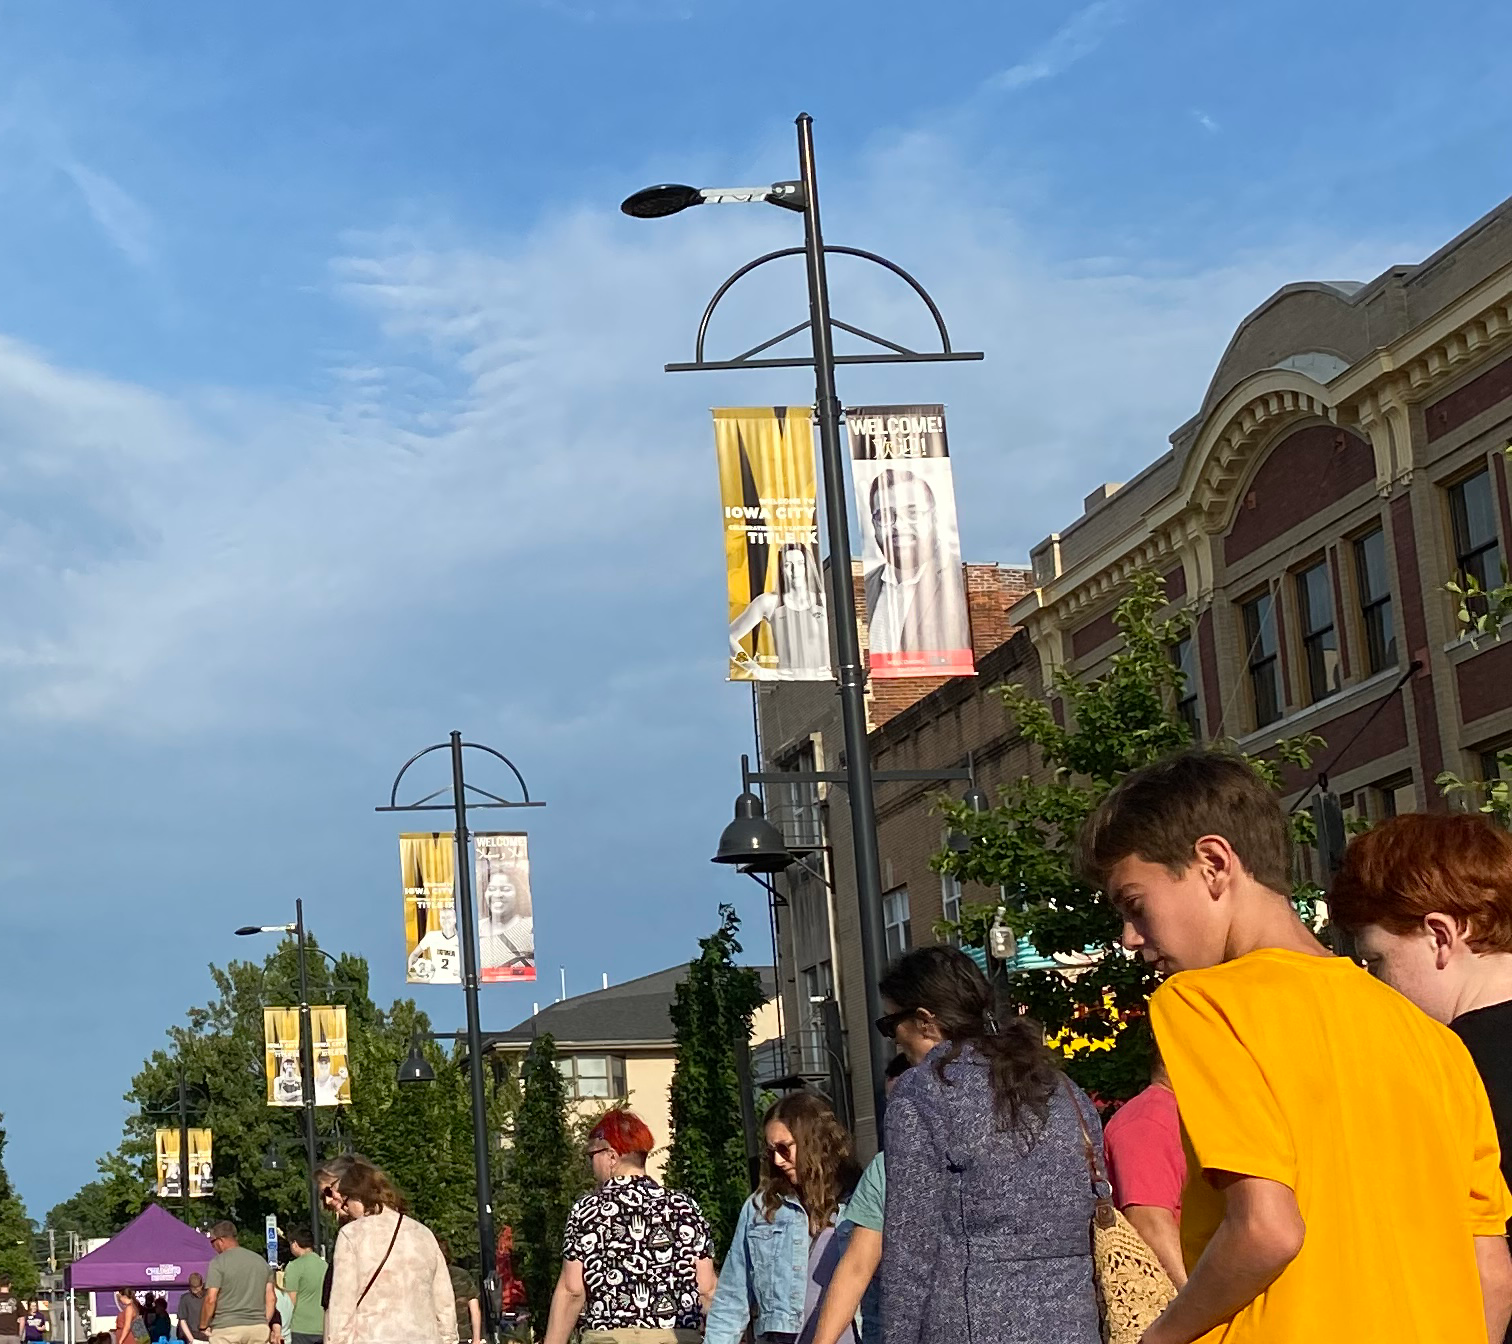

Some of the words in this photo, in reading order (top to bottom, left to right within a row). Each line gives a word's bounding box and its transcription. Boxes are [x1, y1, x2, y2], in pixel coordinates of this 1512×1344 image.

[850, 416, 943, 435] WELCOME!
[725, 507, 771, 519] IOWA
[776, 507, 816, 519] CITY
[748, 532, 796, 544] TITLE
[800, 532, 818, 544] IX
[441, 959, 449, 969] 2
